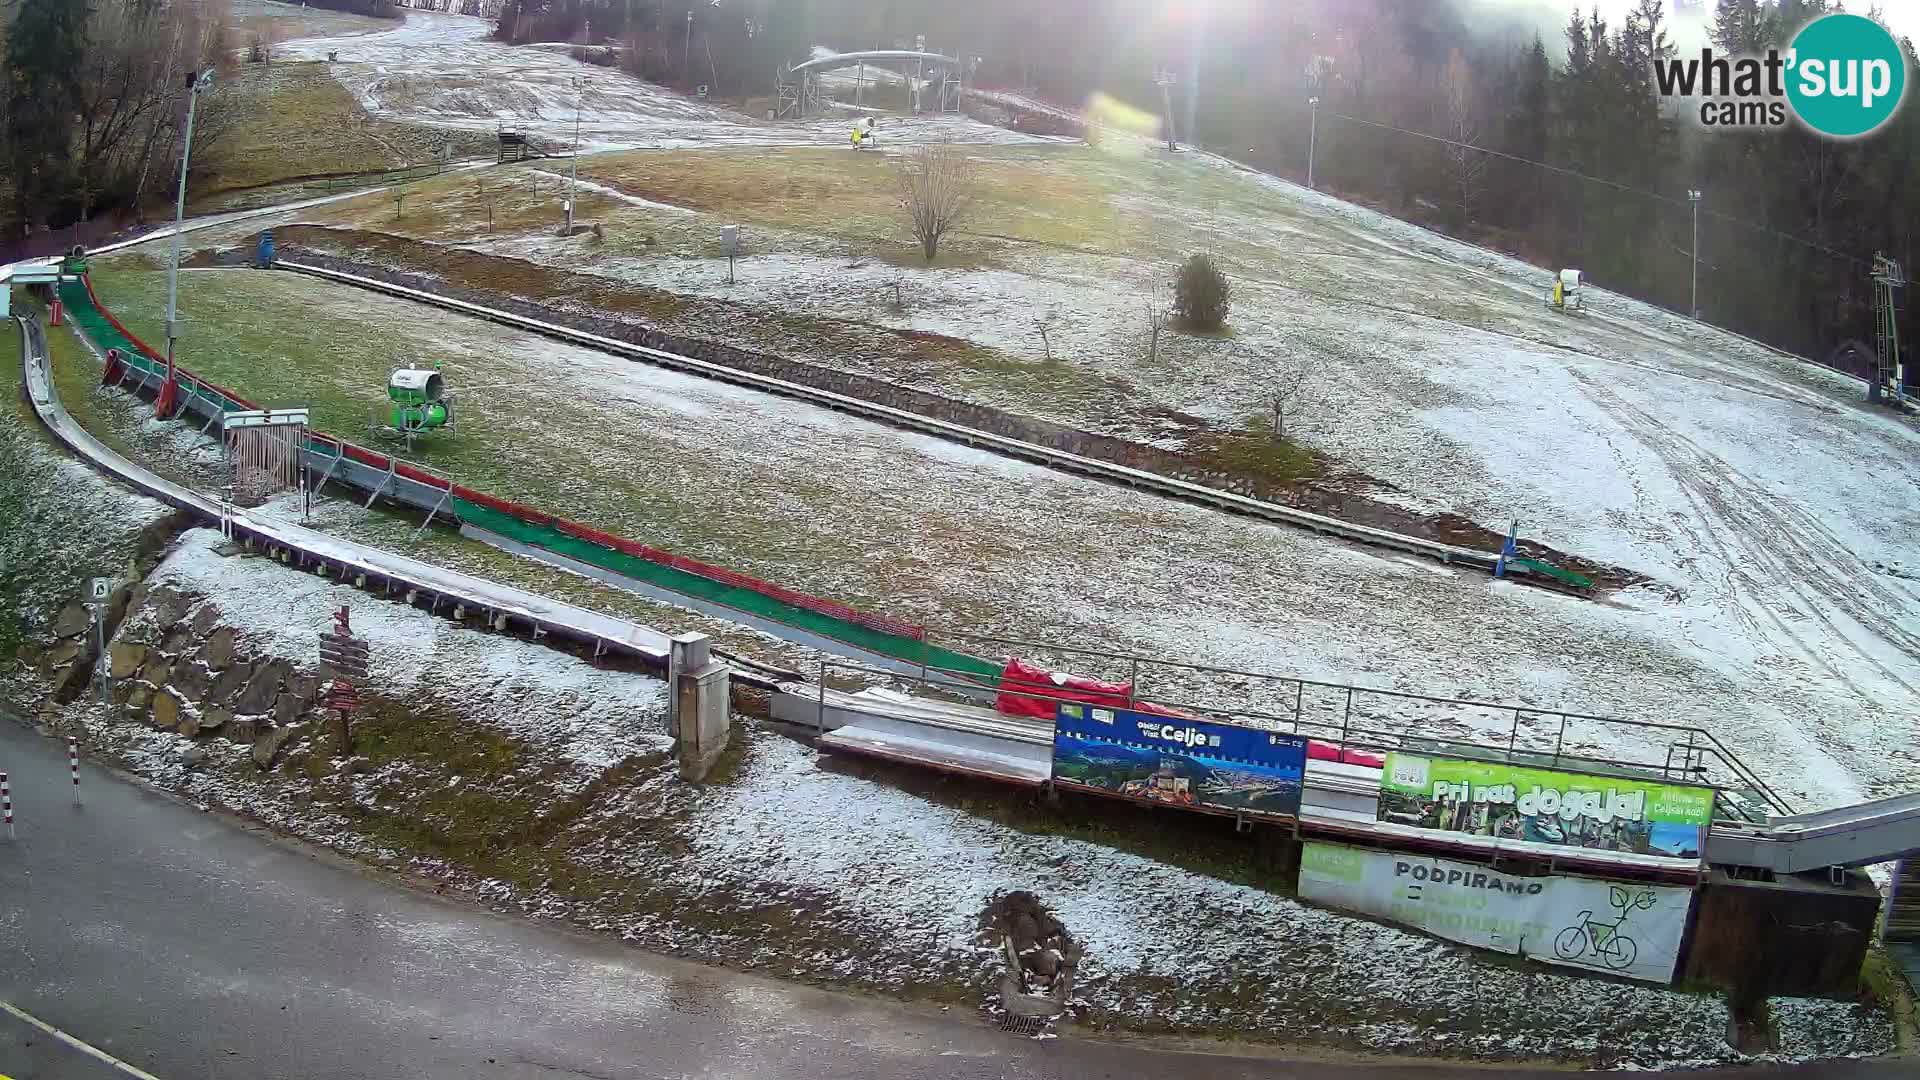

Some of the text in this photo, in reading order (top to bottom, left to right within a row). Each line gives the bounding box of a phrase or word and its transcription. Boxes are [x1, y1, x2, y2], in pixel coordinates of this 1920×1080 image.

[1161, 725, 1206, 747] Celje
[1433, 780, 1469, 802] Pri
[1473, 785, 1516, 805] nas
[1517, 784, 1643, 823] dogaja!
[1395, 861, 1543, 895] PODPIRAMO
